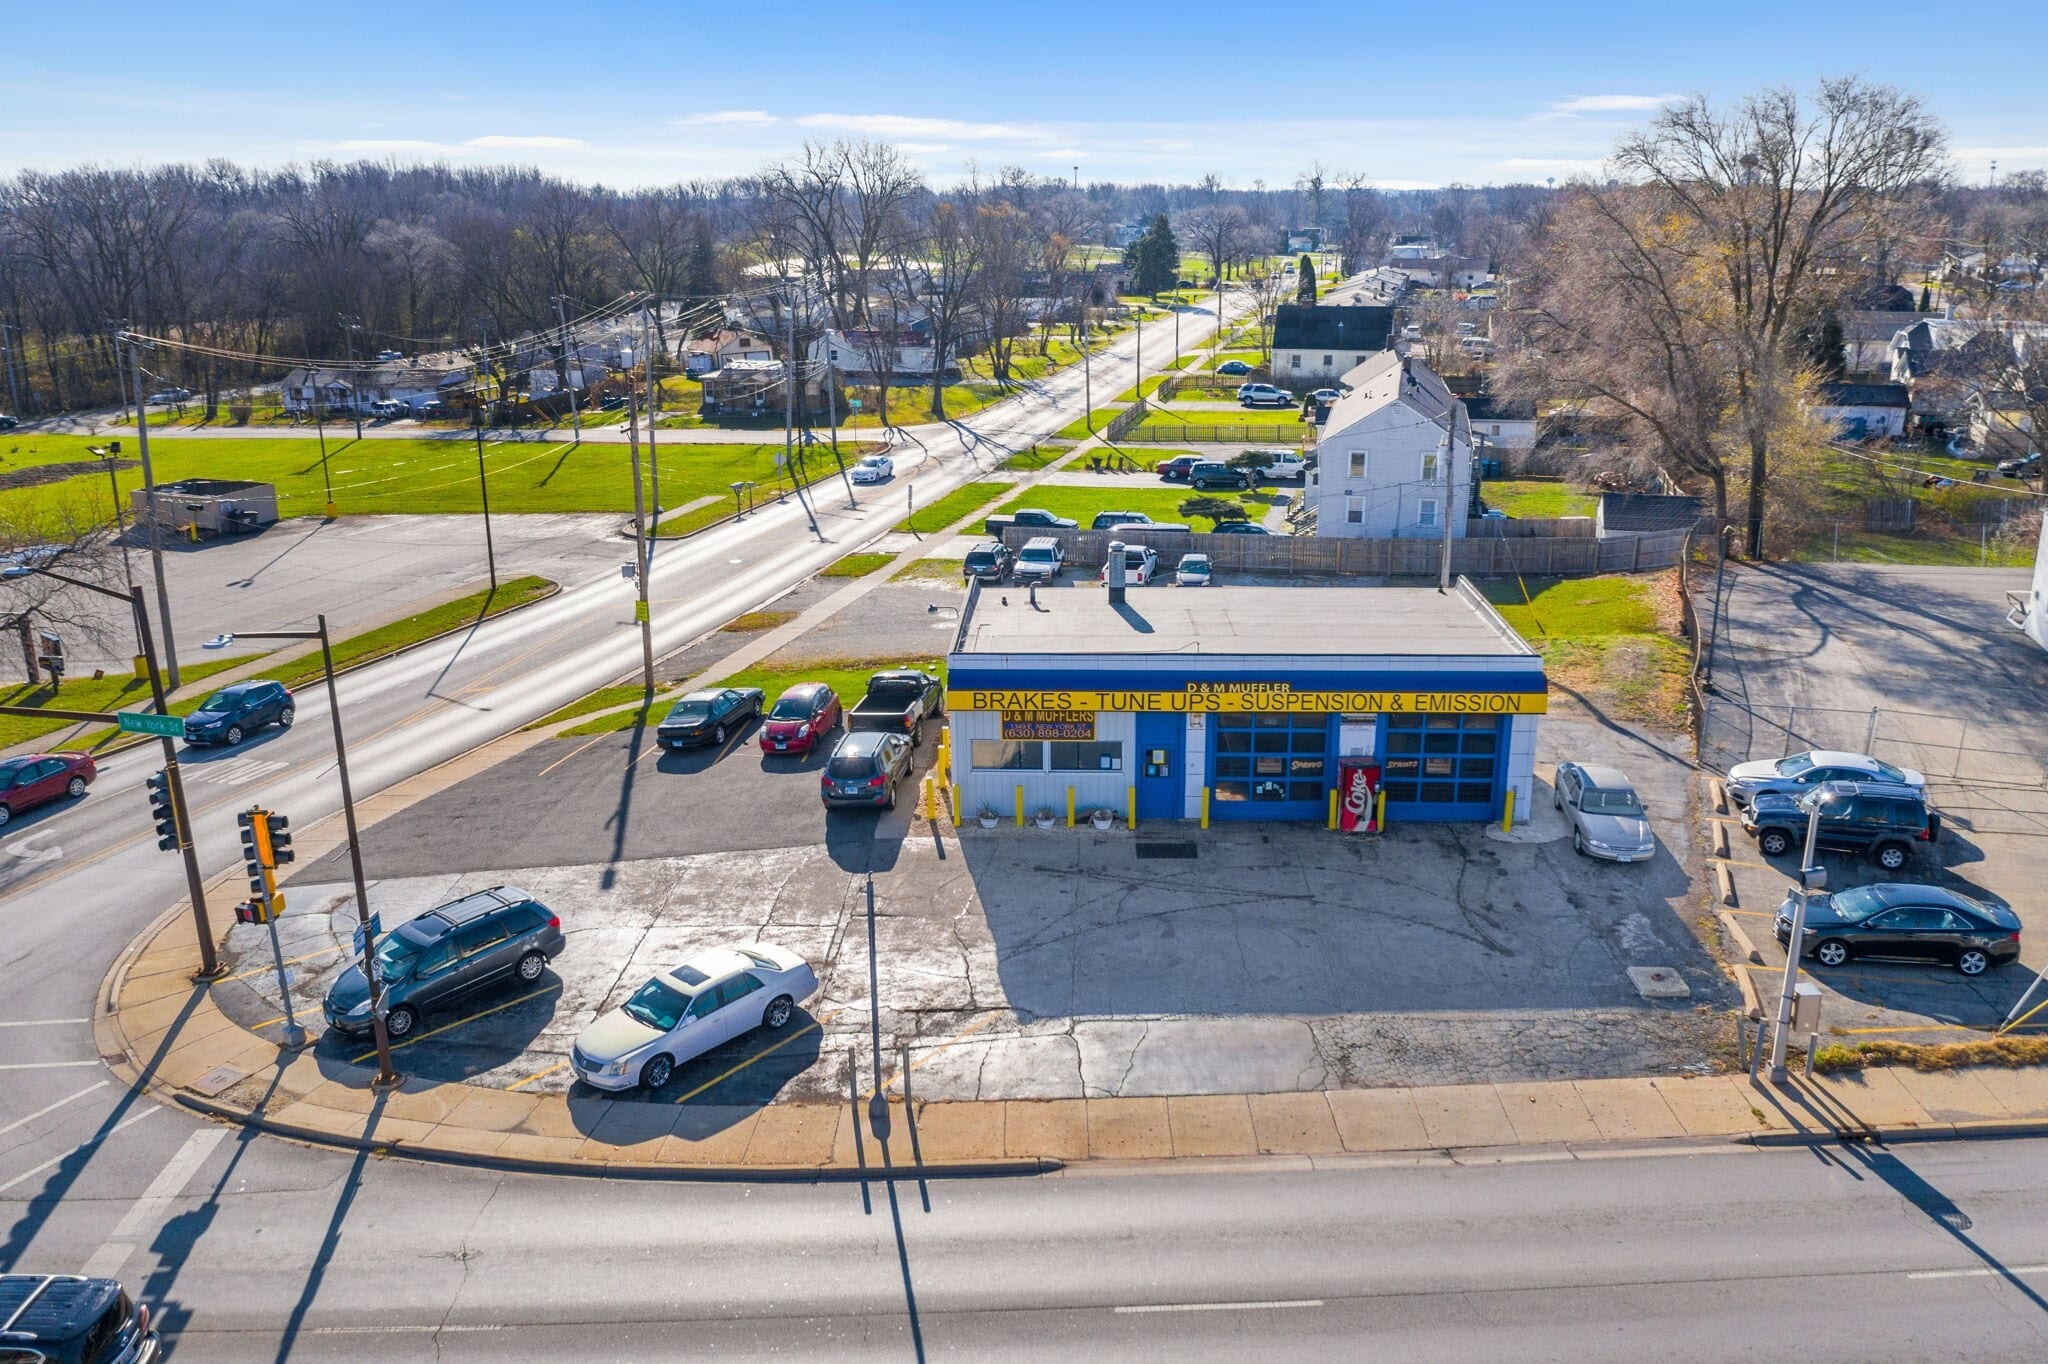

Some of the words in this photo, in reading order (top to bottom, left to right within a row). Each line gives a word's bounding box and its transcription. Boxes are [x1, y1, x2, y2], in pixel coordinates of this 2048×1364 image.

[1187, 683, 1198, 693] D
[1200, 683, 1210, 693] &
[1213, 683, 1225, 693] M
[1229, 683, 1291, 693] MUFFLER
[973, 692, 1072, 710] BRAKES
[1095, 693, 1162, 710] TUNE
[1171, 693, 1220, 711] UPS
[1240, 693, 1383, 711] SUSPENSION
[1390, 694, 1404, 711] &
[1415, 694, 1521, 712] EMISSION
[1003, 711, 1011, 721] D
[1025, 711, 1033, 722] M
[1036, 711, 1094, 722] MUFFLERS
[124, 716, 142, 729] New
[146, 719, 166, 731] York
[1005, 729, 1035, 739] (630)
[1038, 729, 1091, 738] 898-0204
[1344, 769, 1368, 815] Coke
